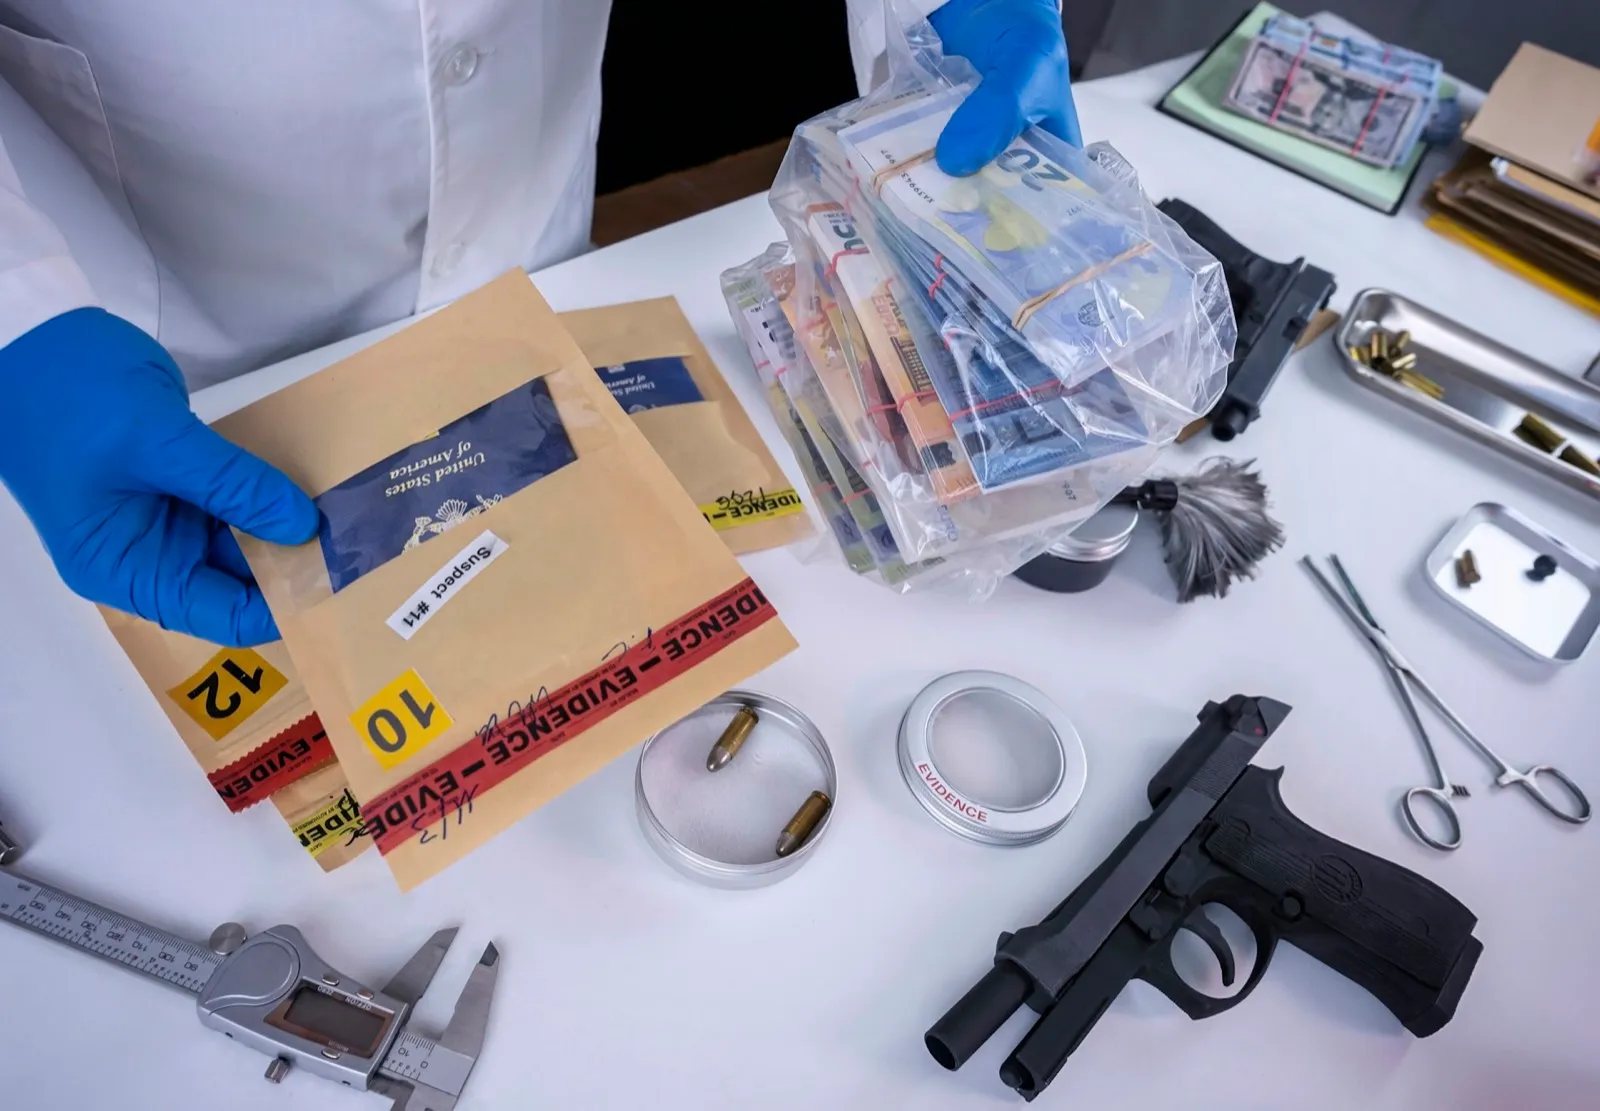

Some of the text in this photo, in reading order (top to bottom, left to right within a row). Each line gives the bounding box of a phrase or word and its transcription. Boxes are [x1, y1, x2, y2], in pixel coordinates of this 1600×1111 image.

[624, 381, 655, 394] United
[384, 451, 486, 497] United States
[389, 440, 470, 479] of America
[402, 545, 491, 627] Suspect #11
[187, 658, 263, 718] 12
[367, 689, 434, 753] 10
[486, 665, 637, 765] EVIDENCE
[918, 763, 988, 823] EVIDENCE
[132, 941, 147, 951] 110
[158, 952, 175, 962] 100
